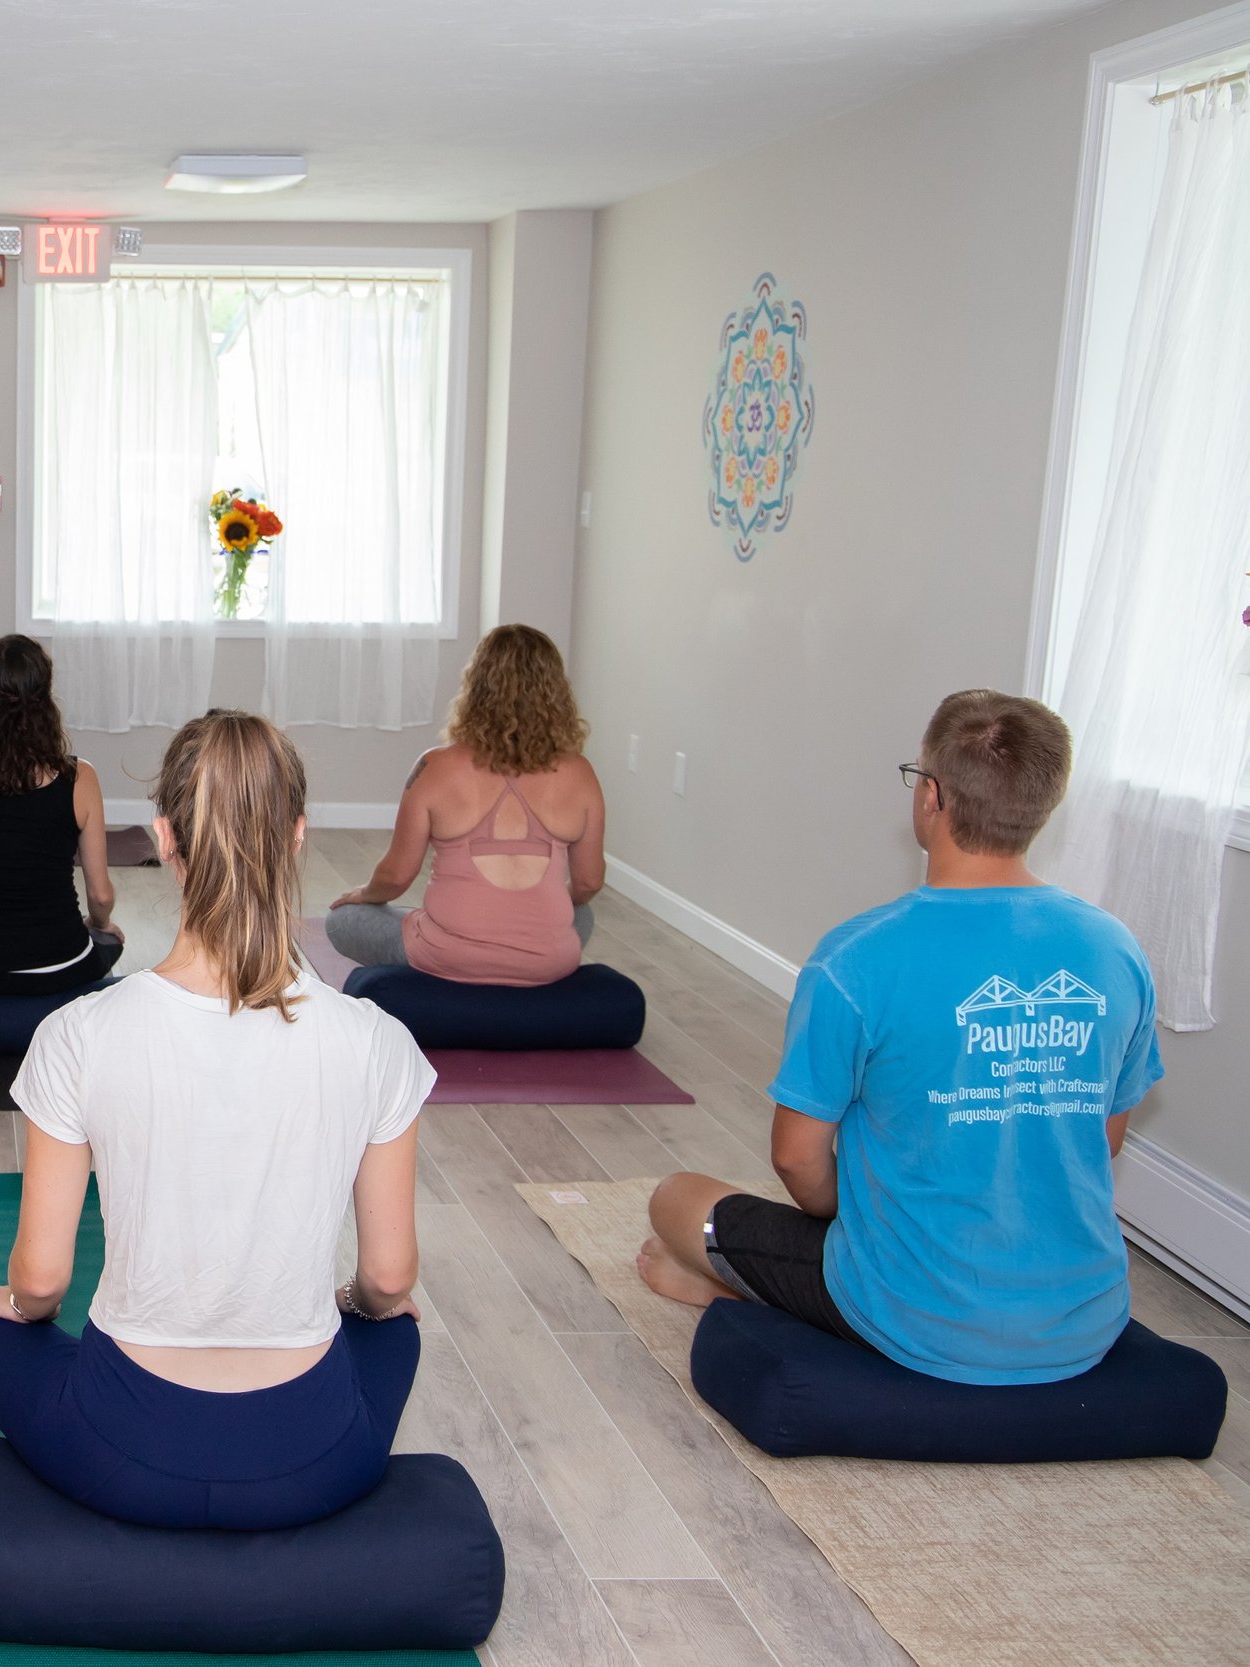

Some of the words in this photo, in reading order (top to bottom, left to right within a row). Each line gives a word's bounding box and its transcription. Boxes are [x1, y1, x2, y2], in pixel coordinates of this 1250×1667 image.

[38, 226, 100, 274] EXIT
[991, 1058, 1047, 1077] Conactors
[1049, 1056, 1066, 1073] LLC
[927, 1089, 958, 1104] Where
[958, 1086, 1001, 1101] Dreams
